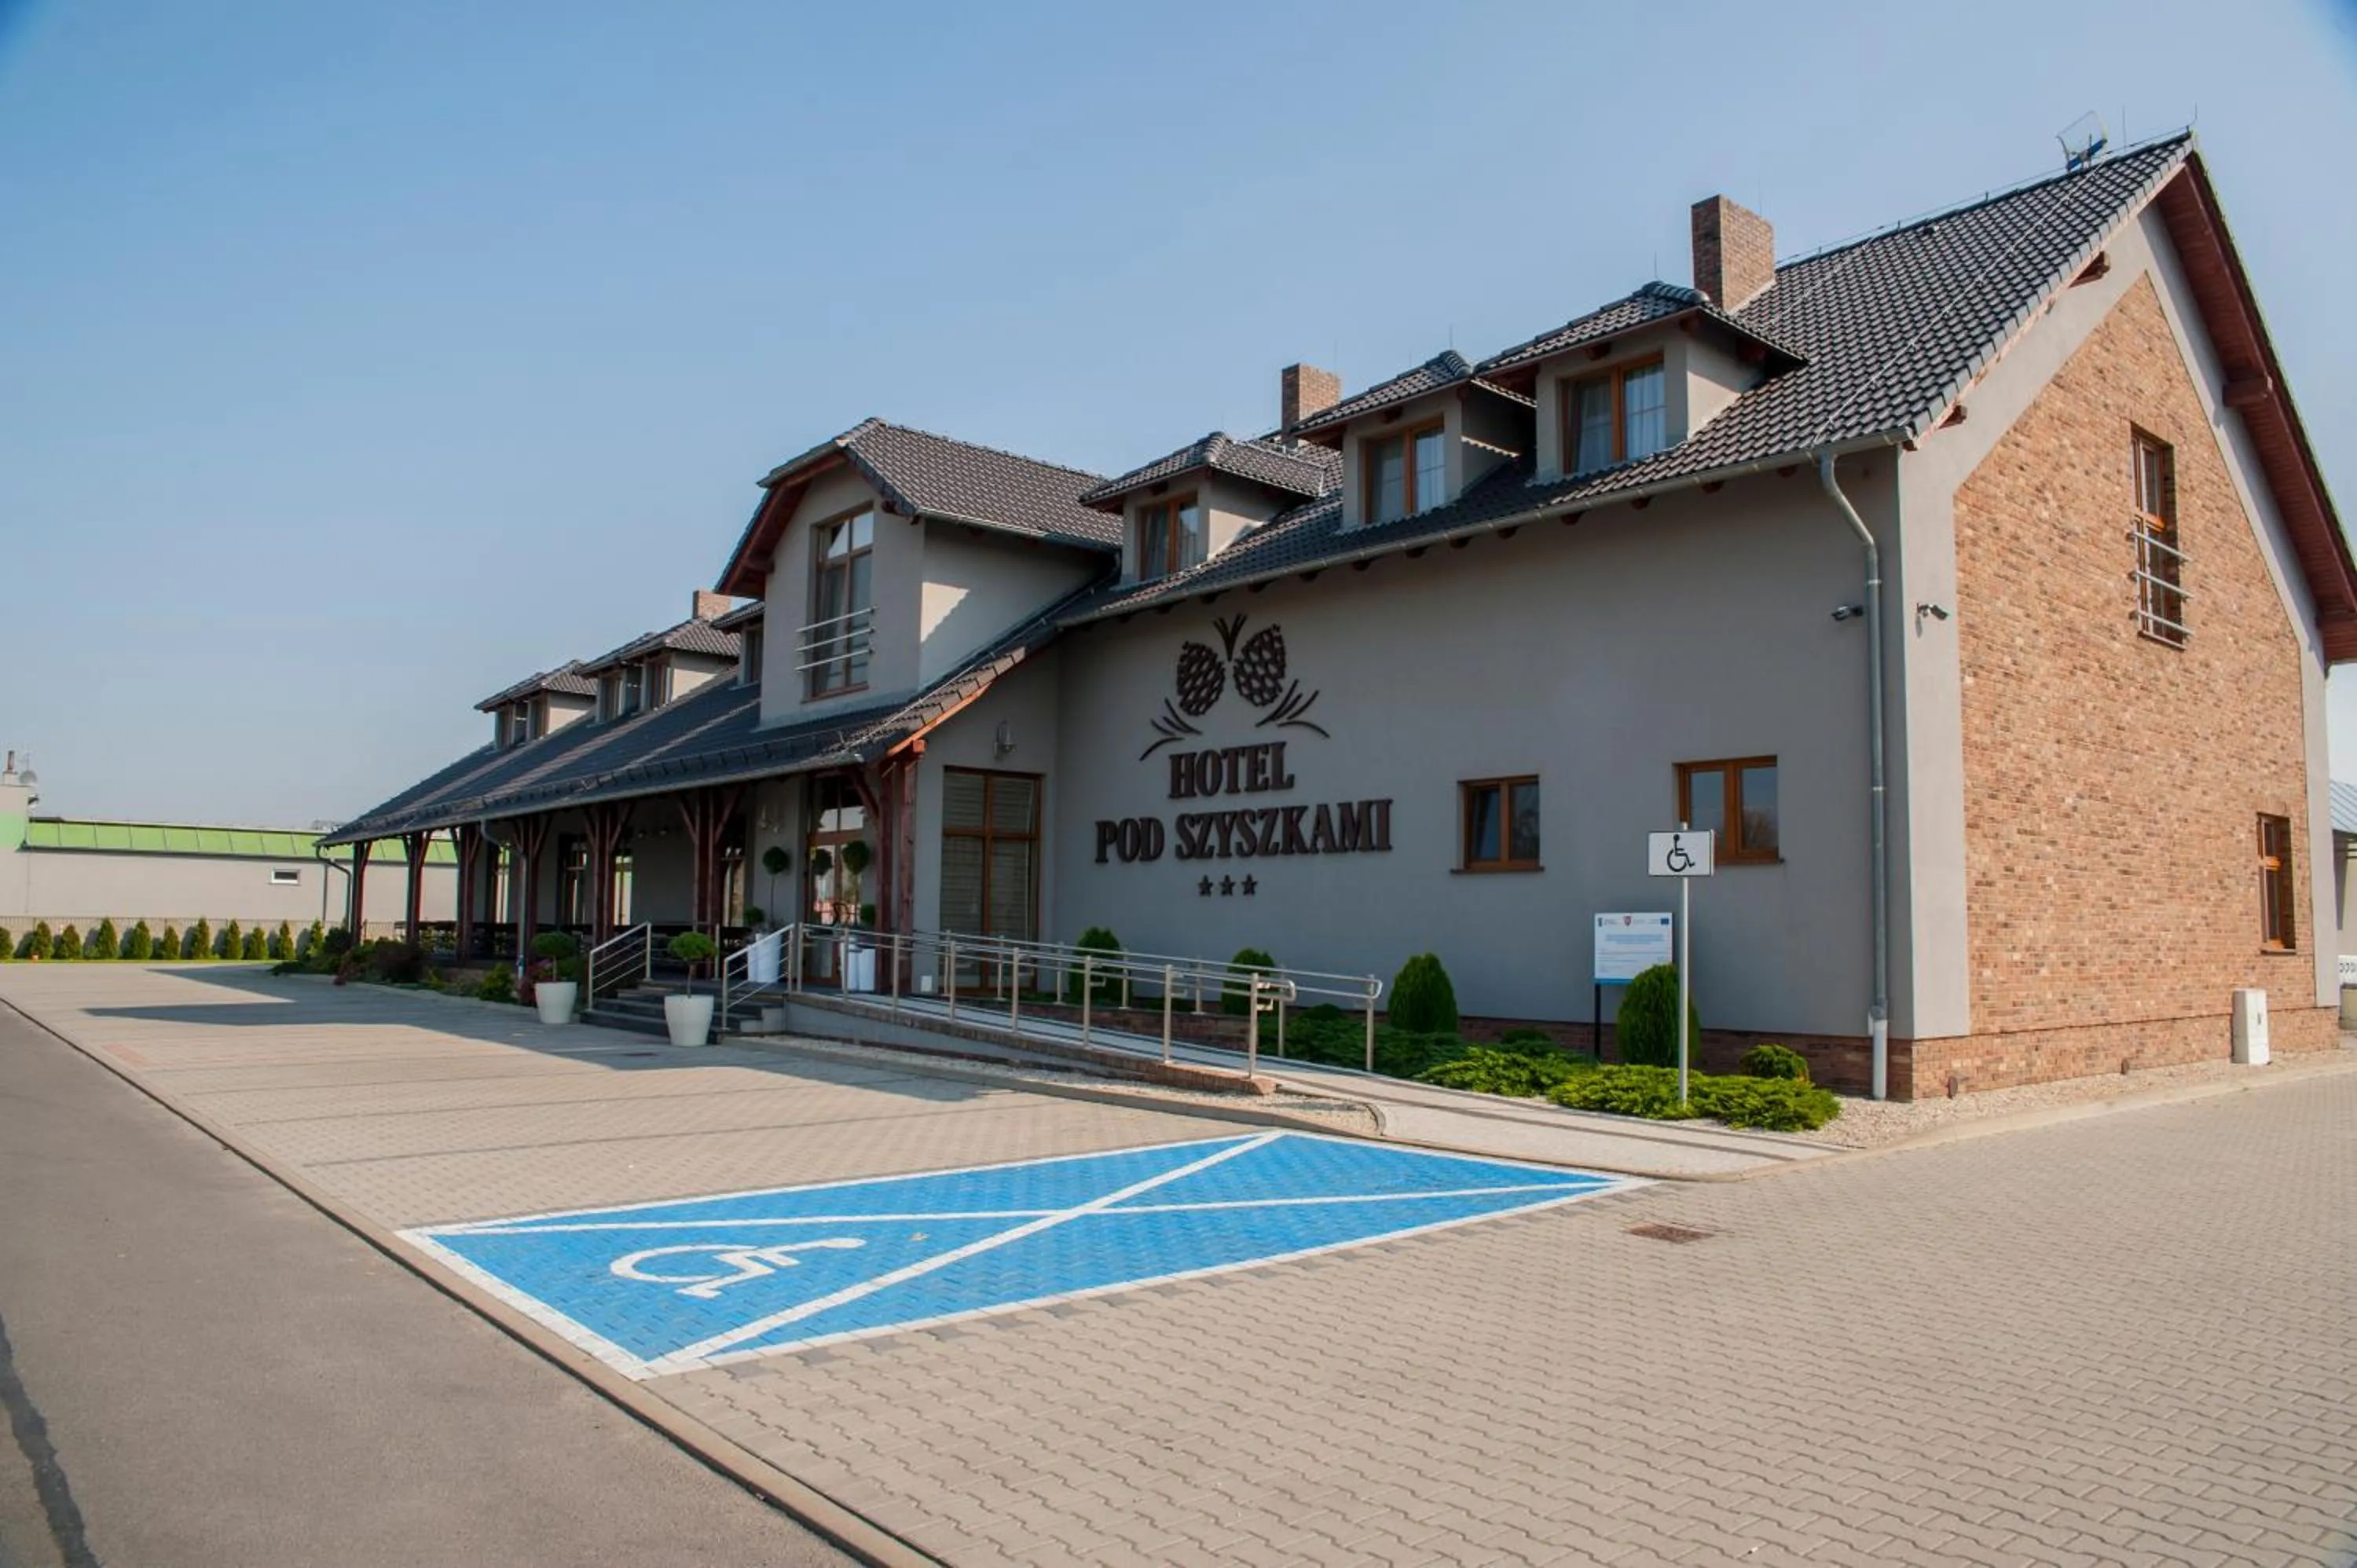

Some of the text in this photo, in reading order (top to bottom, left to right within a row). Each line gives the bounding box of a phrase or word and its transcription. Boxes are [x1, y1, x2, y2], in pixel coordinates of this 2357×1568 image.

[1168, 741, 1295, 799] HOTEL
[1094, 799, 1393, 863] POD SZYSZKAMI
